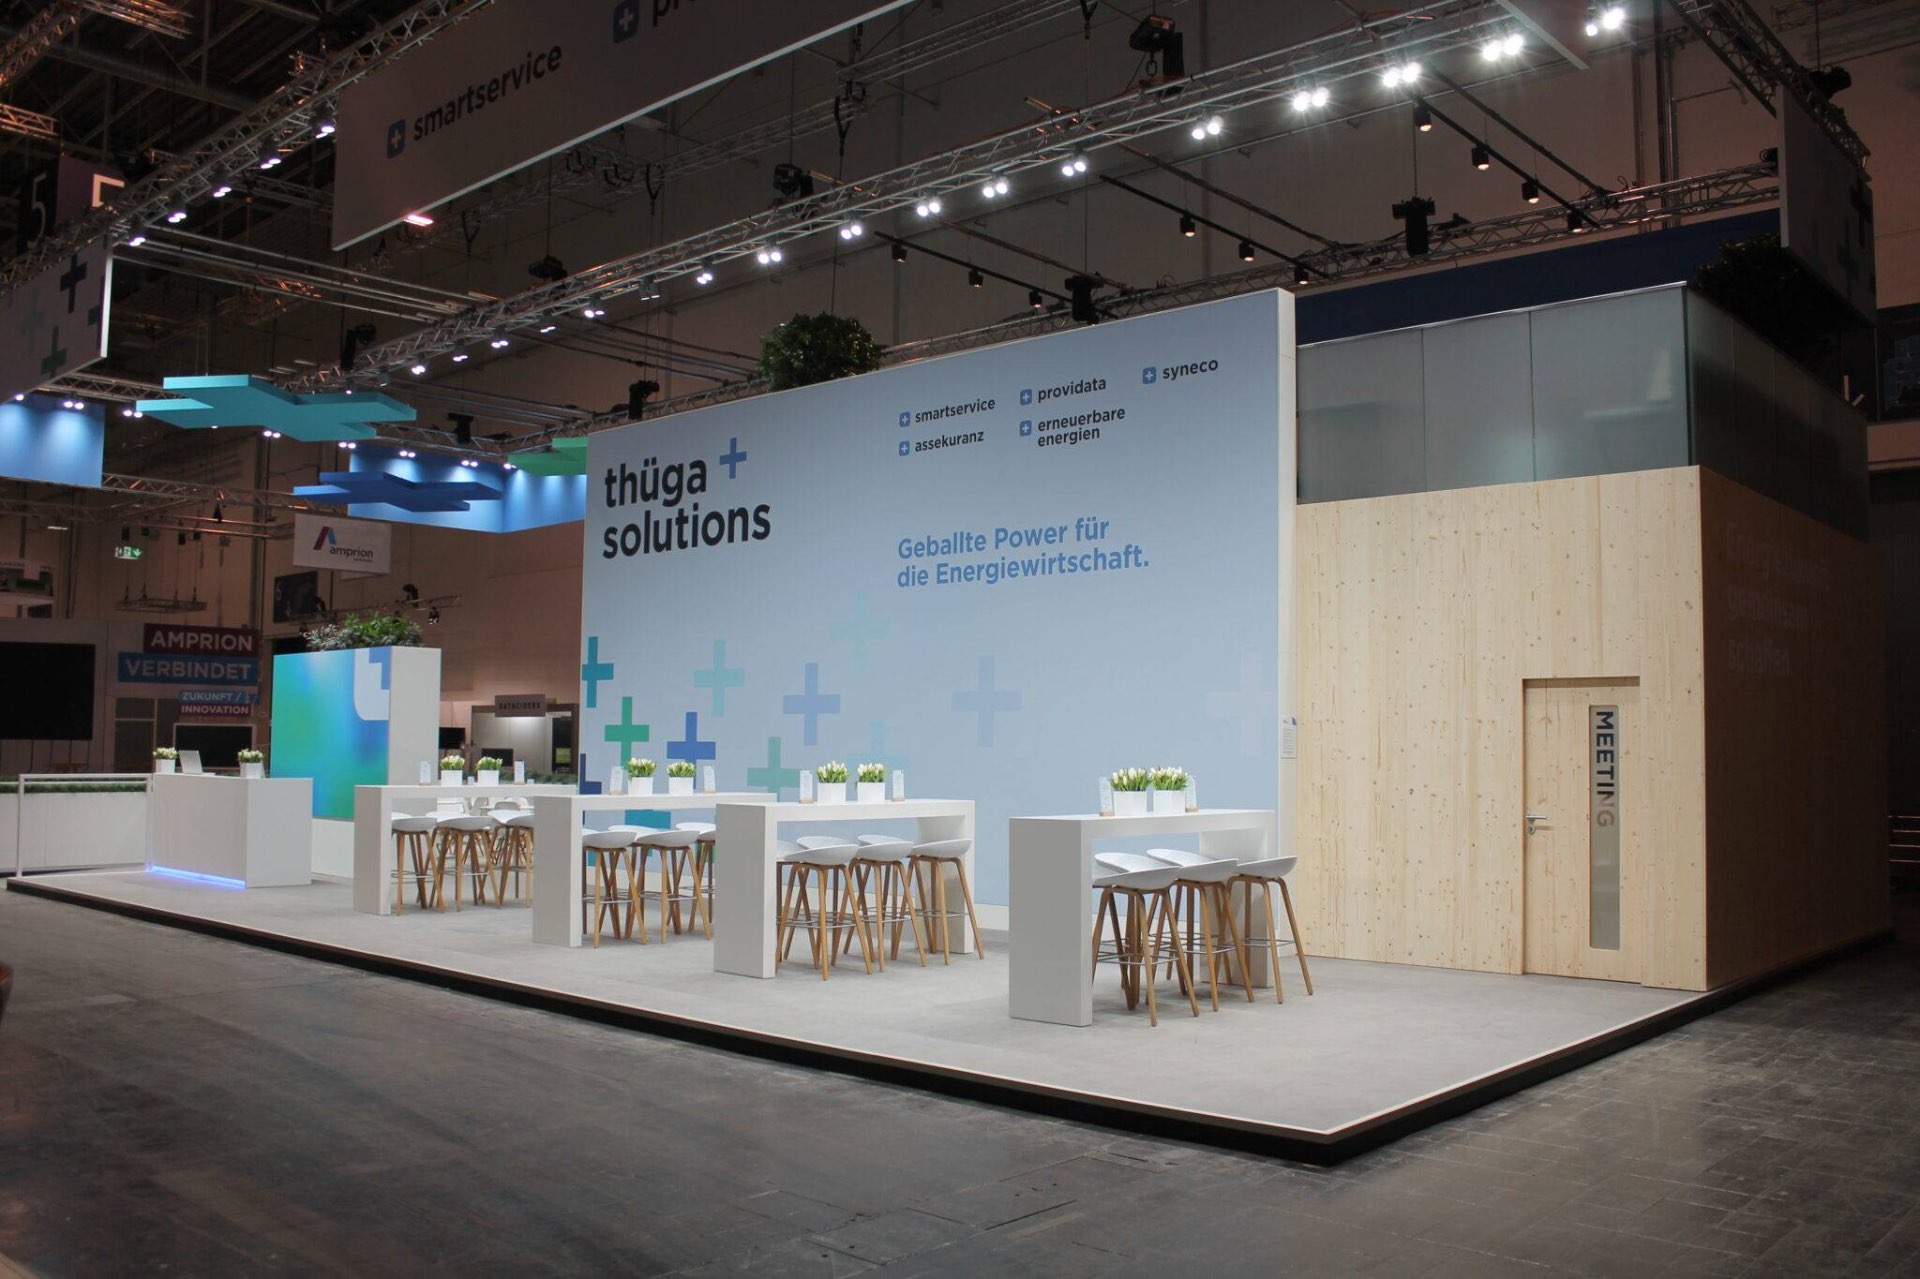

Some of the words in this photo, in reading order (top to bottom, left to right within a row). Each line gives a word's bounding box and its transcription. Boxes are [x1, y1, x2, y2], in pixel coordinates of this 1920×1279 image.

[413, 45, 562, 141] smartservice
[1162, 359, 1219, 380] syneco
[1037, 378, 1107, 403] providata
[914, 398, 996, 423] smartservice
[1037, 406, 1126, 433] erneuerbare
[914, 430, 985, 452] assekuranz
[1037, 427, 1100, 448] energien
[604, 456, 708, 509] thüga
[602, 502, 772, 560] solutions
[898, 531, 987, 560] Geballte
[994, 524, 1068, 550] Power
[1075, 516, 1110, 542] für
[329, 546, 374, 558] amprion
[897, 564, 929, 588] die
[935, 544, 1150, 585] Energiewirtschaft.
[150, 630, 253, 652] AMPRION
[124, 659, 253, 681] VERBINDET
[182, 691, 234, 702] ZUKUNFT
[181, 704, 250, 715] INNOVATION
[1596, 711, 1615, 828] MEETING
